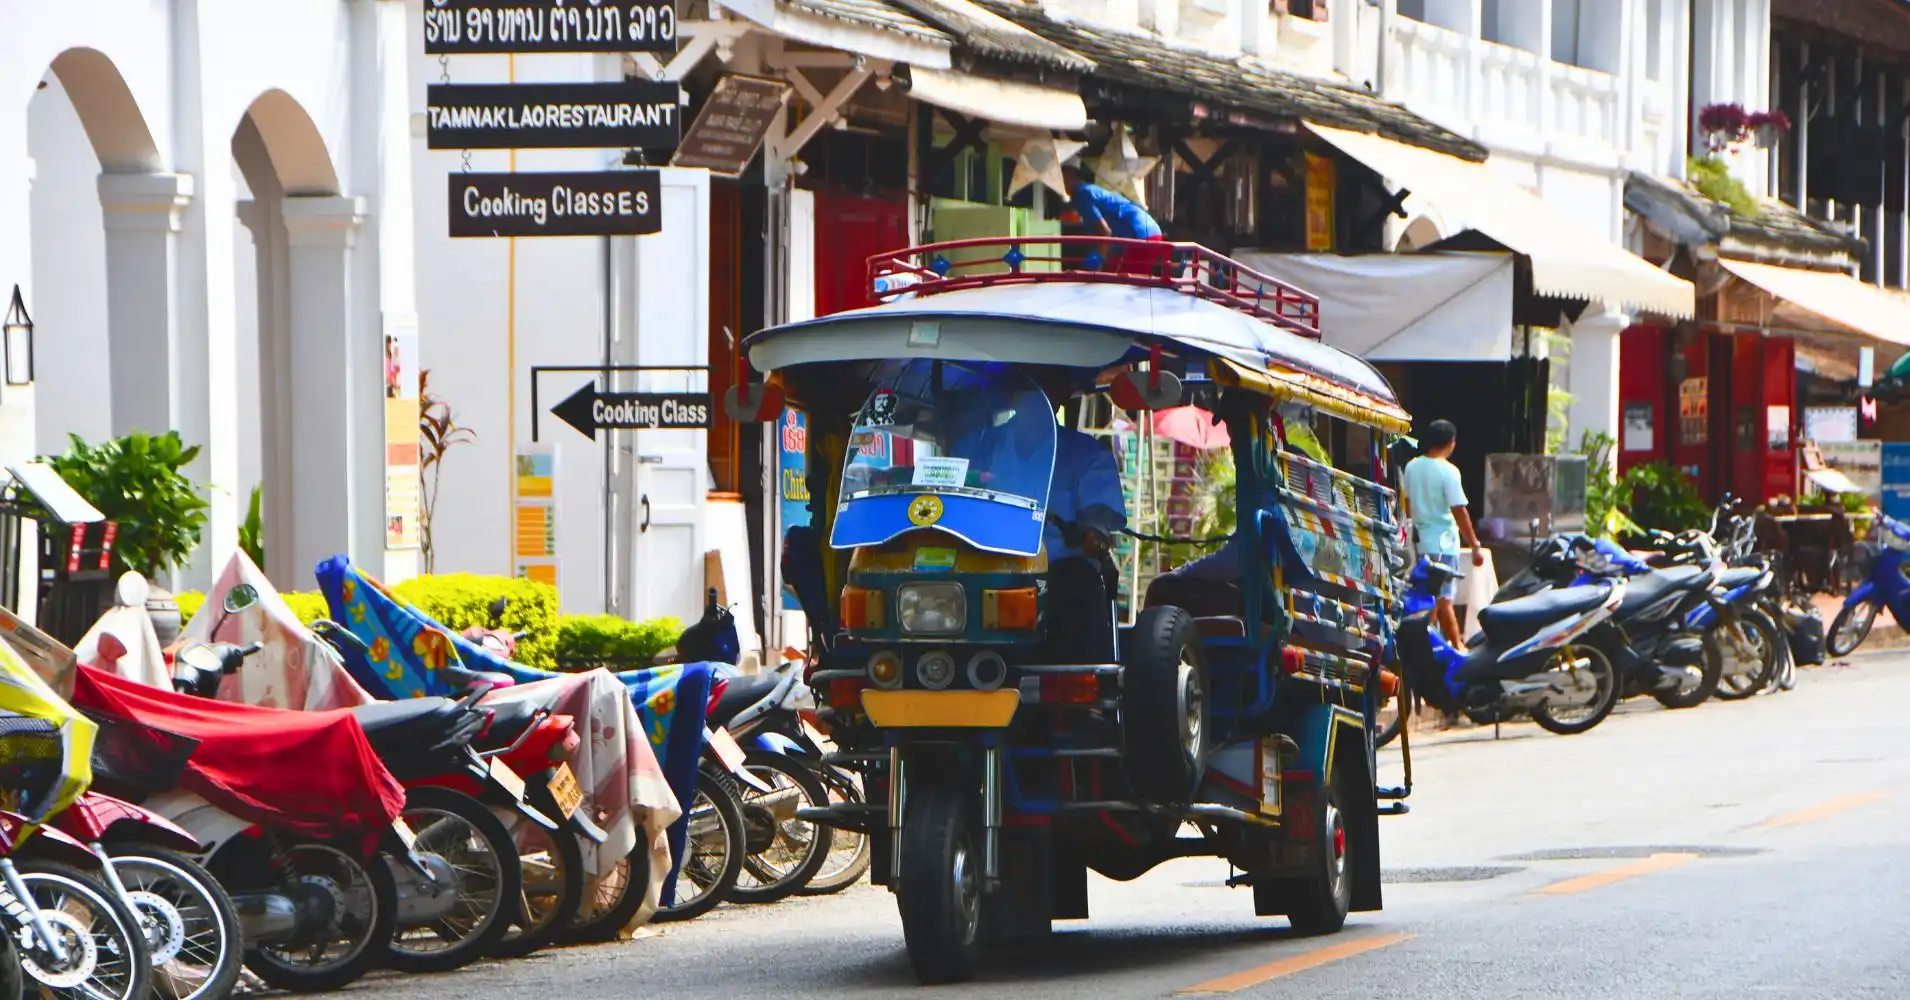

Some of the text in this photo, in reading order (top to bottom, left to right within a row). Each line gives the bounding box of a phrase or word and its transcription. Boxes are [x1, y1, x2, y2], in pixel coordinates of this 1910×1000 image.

[464, 186, 547, 224] Cooking
[593, 399, 707, 428] Cooking Class
